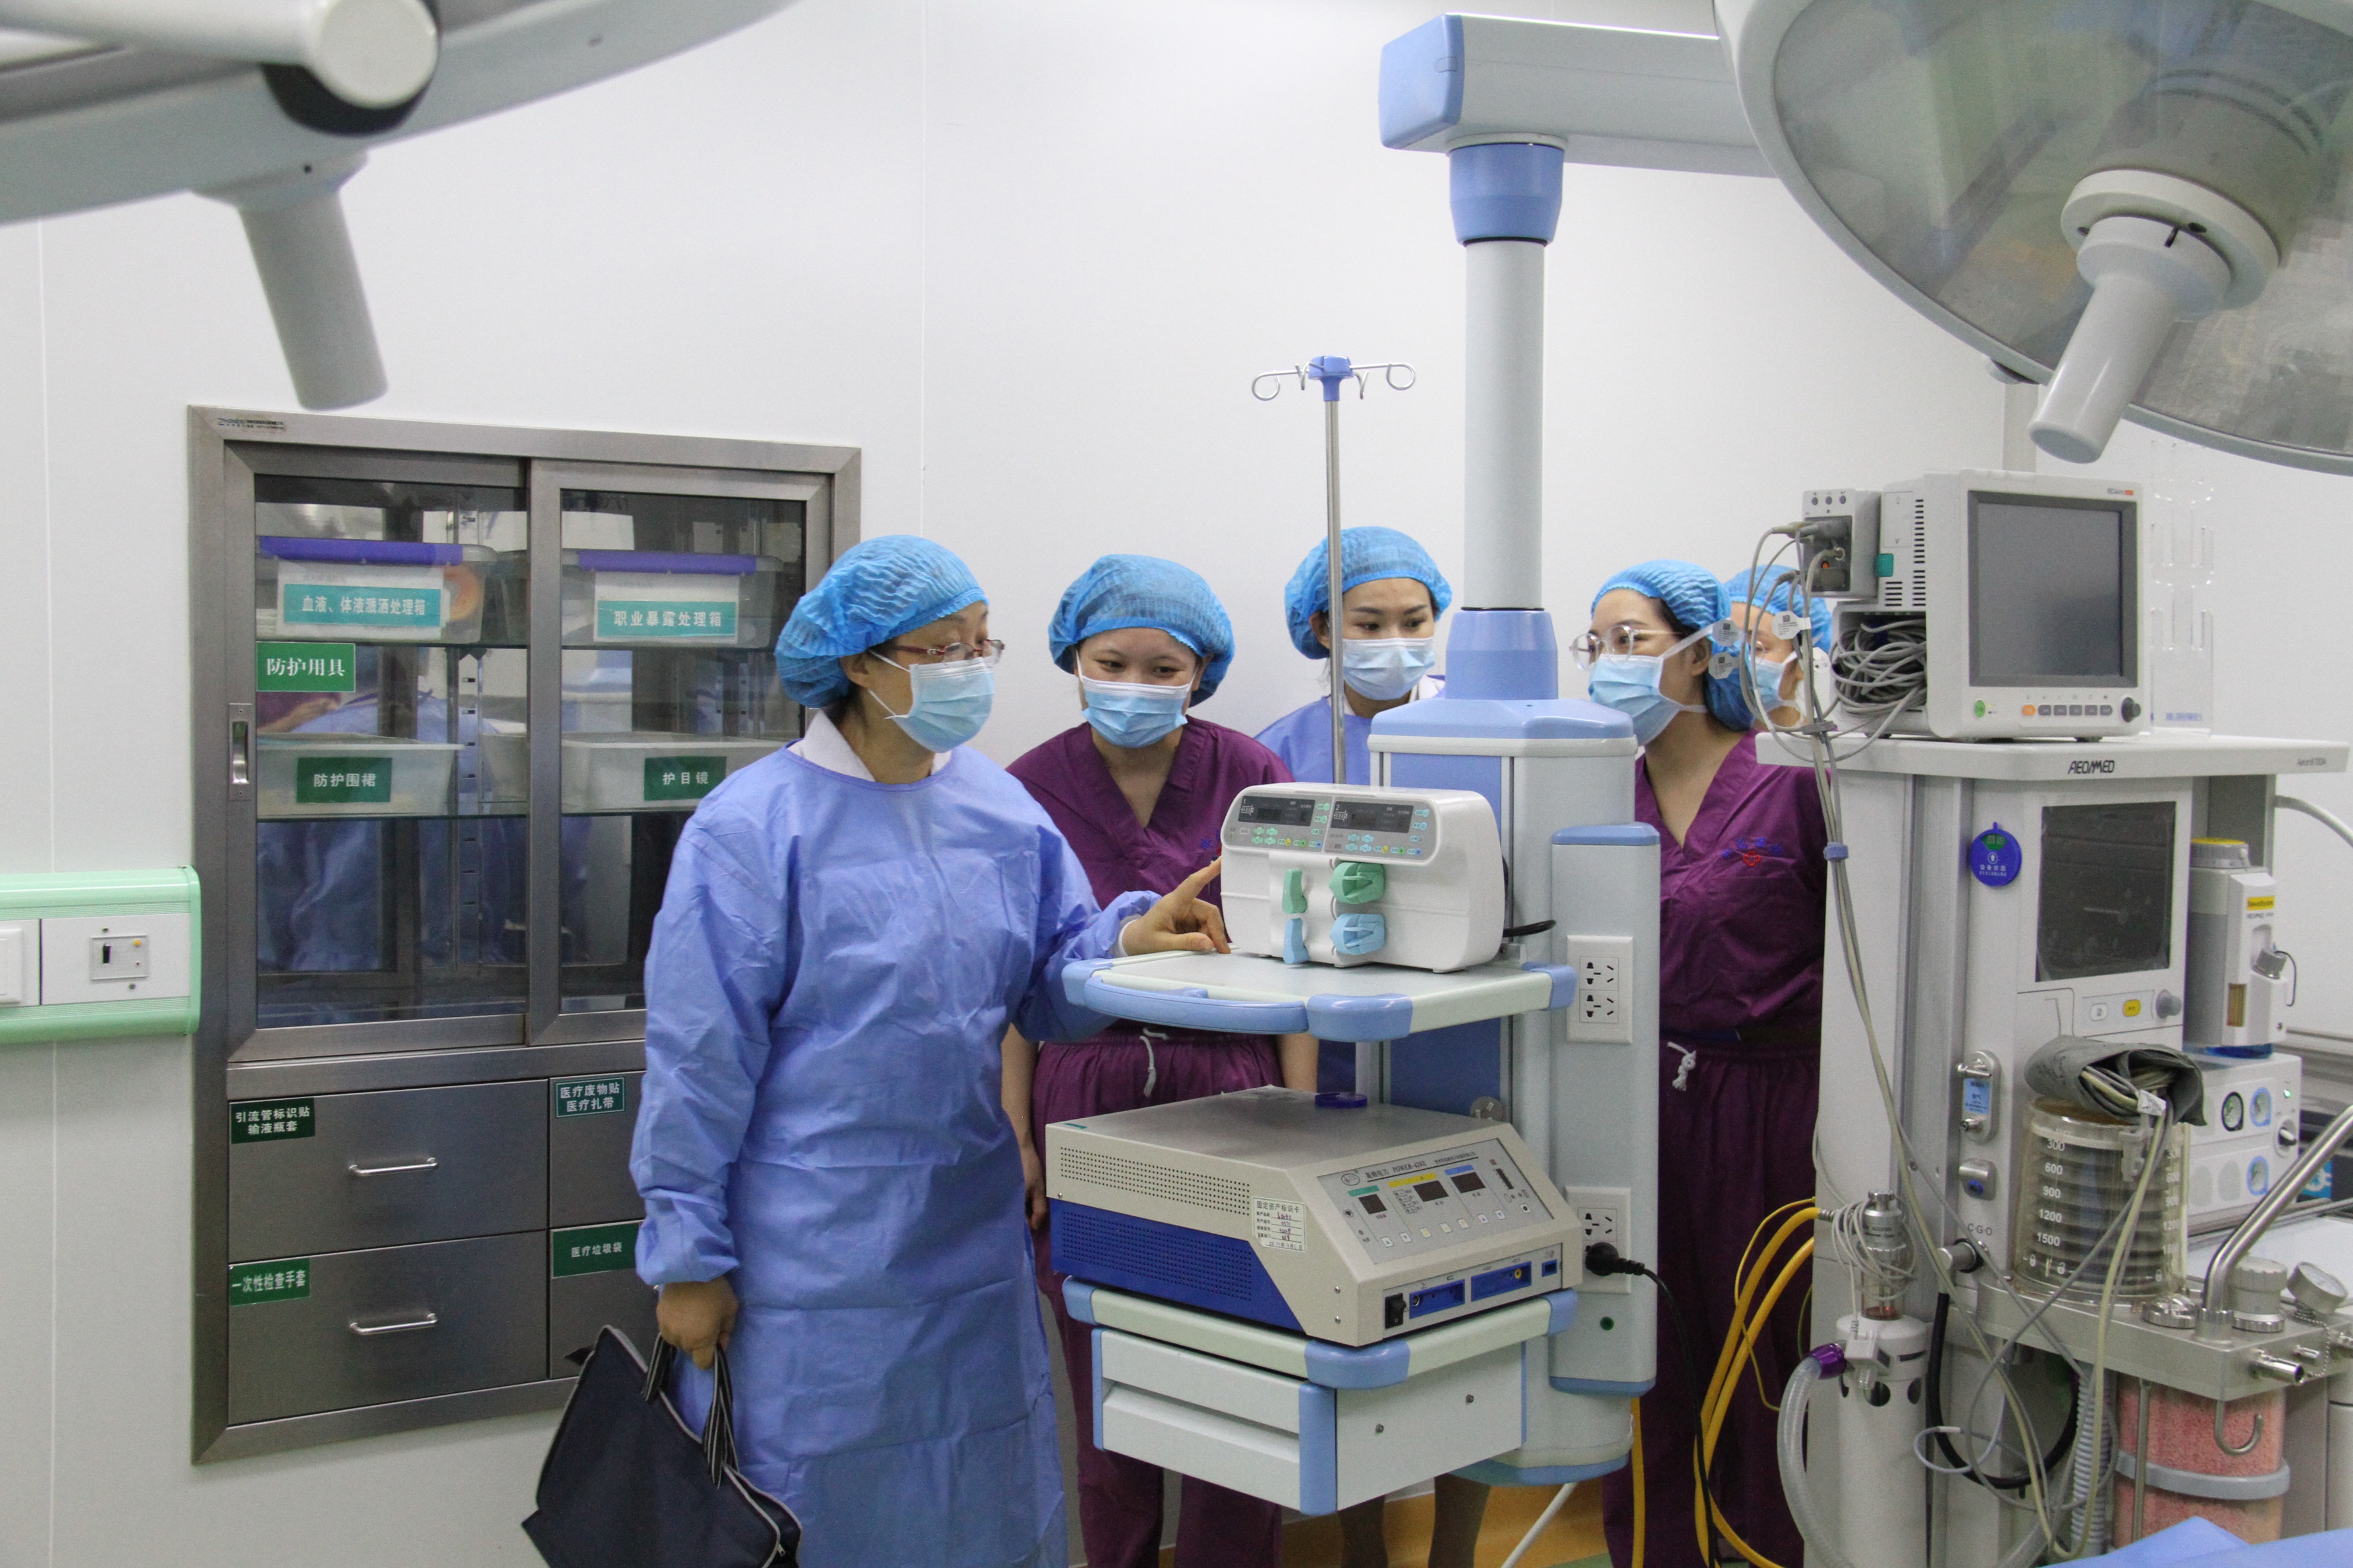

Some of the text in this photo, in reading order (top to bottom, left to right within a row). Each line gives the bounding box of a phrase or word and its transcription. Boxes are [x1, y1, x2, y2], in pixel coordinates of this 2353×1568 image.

[614, 610, 722, 627] 职业暴露处理箱
[266, 657, 345, 676] 防护用具
[313, 773, 376, 787] 防护围裙
[662, 771, 709, 785] 护目镜
[560, 1082, 620, 1099] 医疗废物贴
[566, 1096, 614, 1112] 医疗扎带
[235, 1106, 310, 1122] 引流管标识贴
[247, 1120, 298, 1136] 输液瓶套
[2047, 1139, 2065, 1152] 300
[2045, 1162, 2063, 1175] 600
[2043, 1185, 2061, 1198] 900
[1256, 1201, 1299, 1213] 固定资产标识卡
[2038, 1208, 2062, 1223] 1200
[2037, 1232, 2060, 1246] 1500
[571, 1242, 623, 1258] 医疗垃圾袋
[231, 1269, 306, 1293] 一次性检查手套
